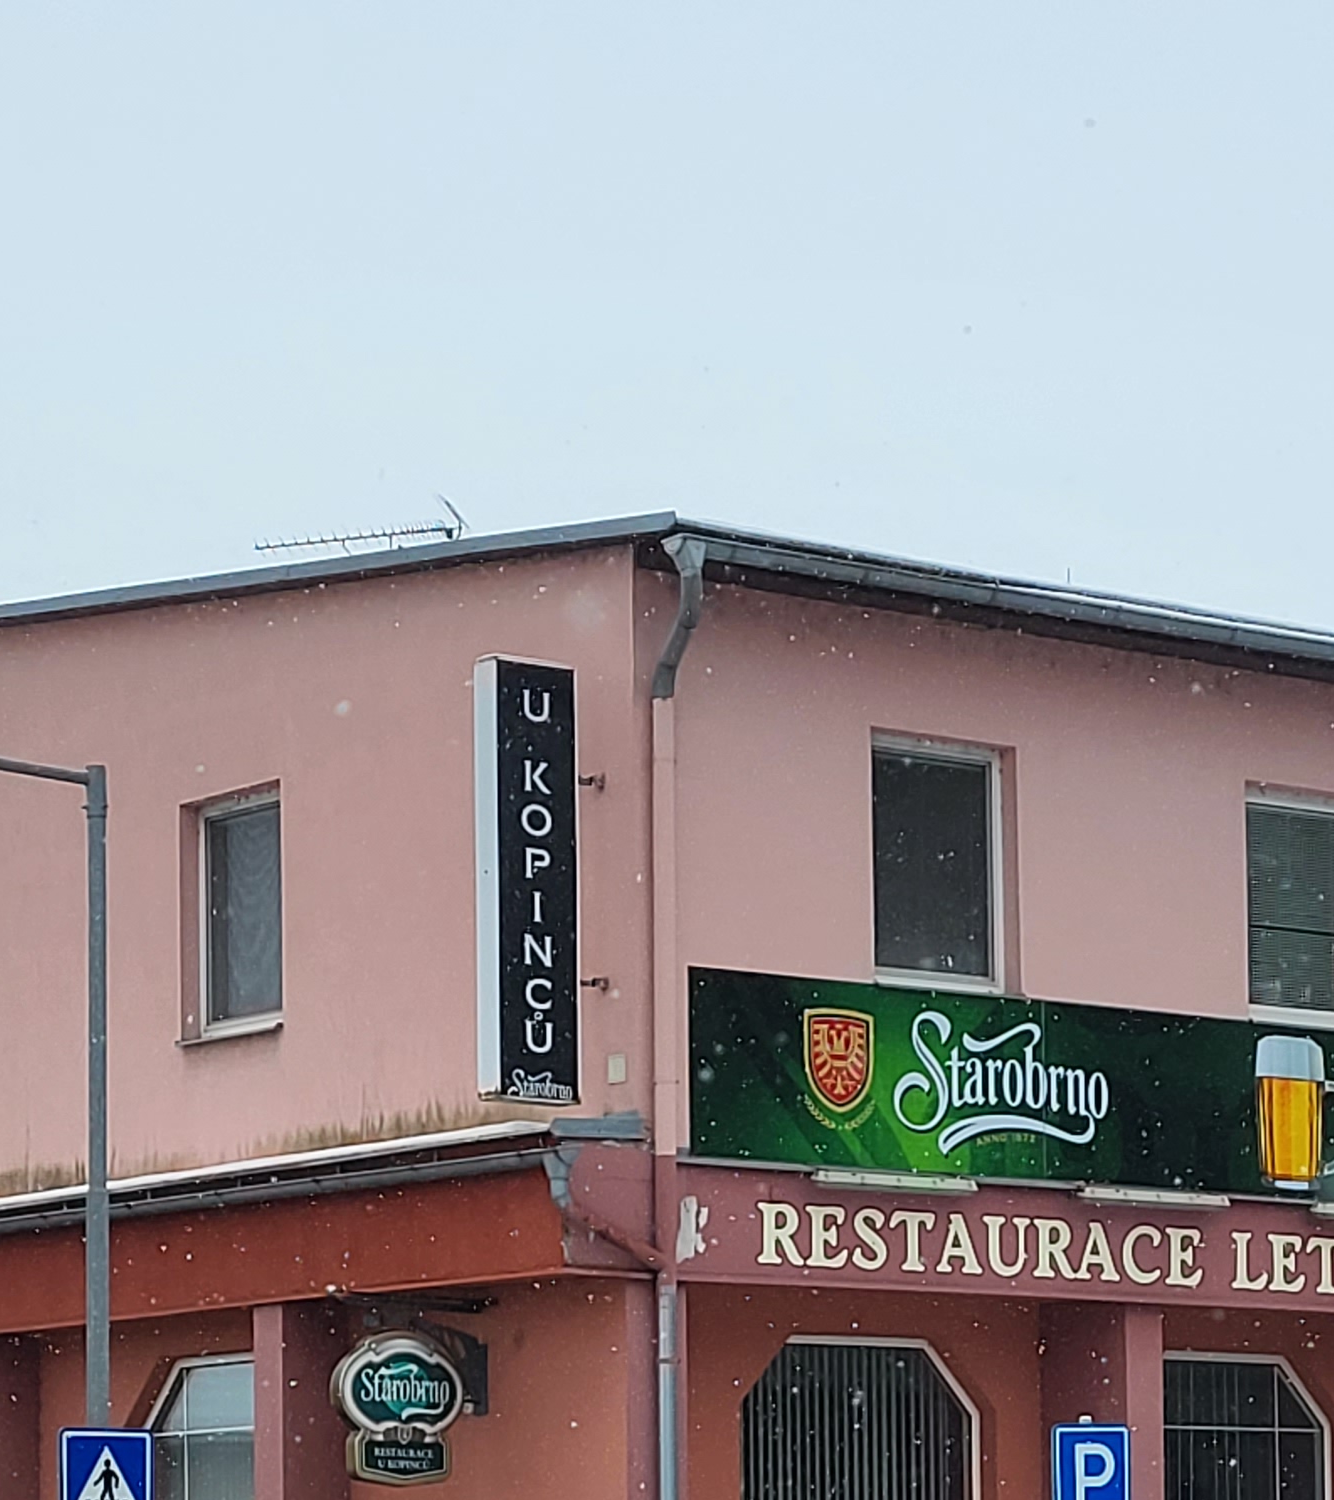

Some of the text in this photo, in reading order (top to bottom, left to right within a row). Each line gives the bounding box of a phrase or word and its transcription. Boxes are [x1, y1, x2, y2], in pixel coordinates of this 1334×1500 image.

[520, 688, 555, 1055] U KOPINCŮ
[894, 1010, 1109, 1155] Starobrno
[756, 1201, 1204, 1289] RESTAURACE
[360, 1362, 450, 1421] Starobrno
